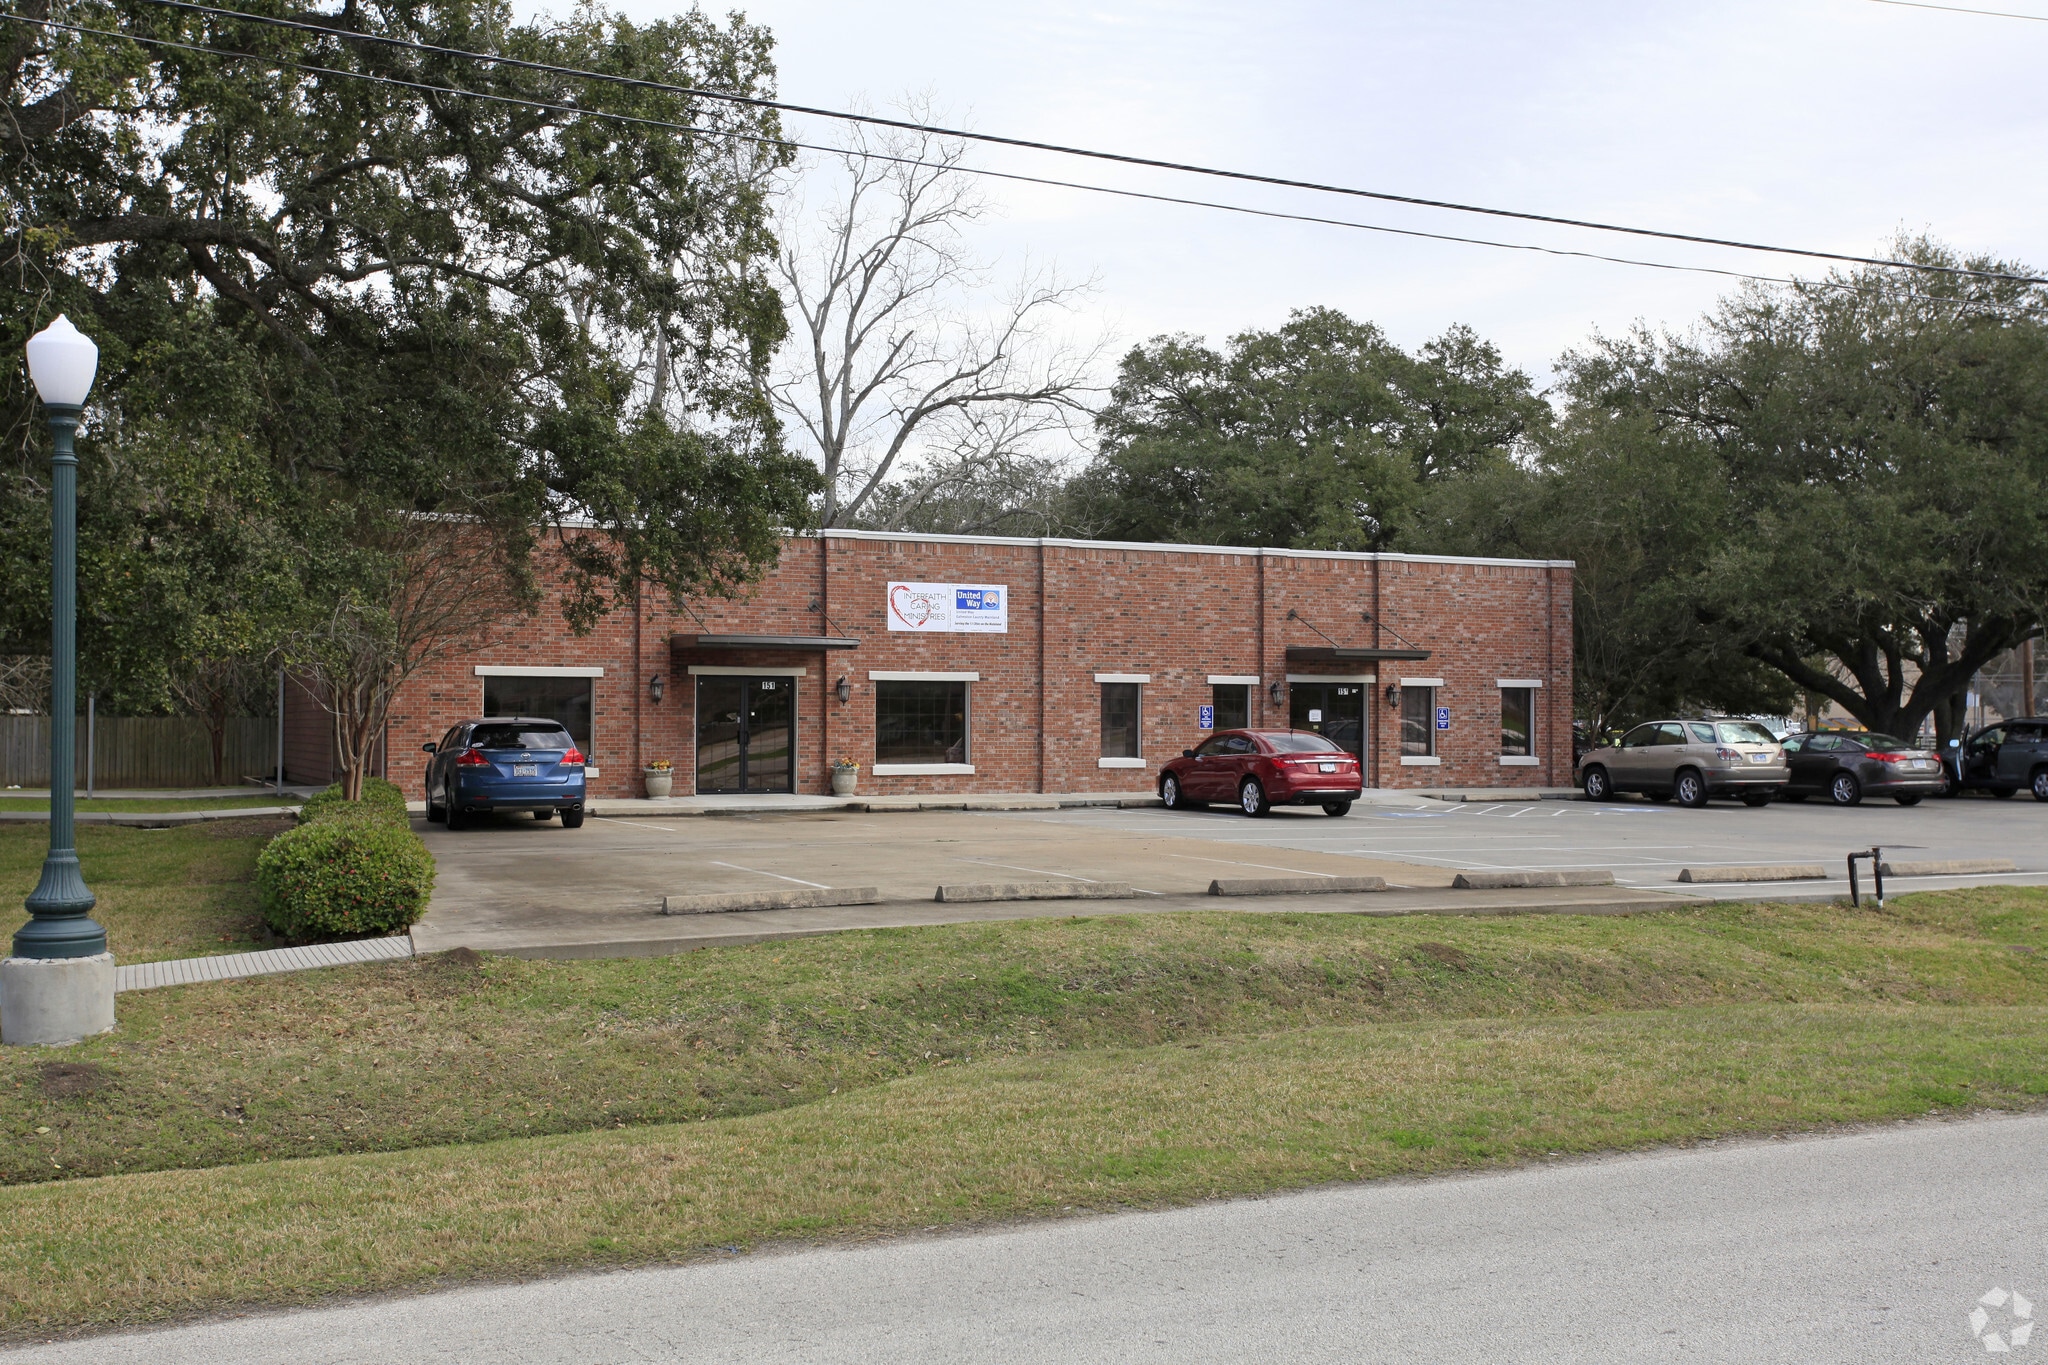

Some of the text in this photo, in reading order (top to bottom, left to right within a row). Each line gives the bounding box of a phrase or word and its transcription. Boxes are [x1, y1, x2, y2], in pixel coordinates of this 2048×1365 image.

[957, 591, 981, 599] United
[910, 602, 940, 610] CARING
[966, 599, 981, 609] Way
[904, 612, 946, 621] MINISTRIES
[763, 681, 775, 690] 151
